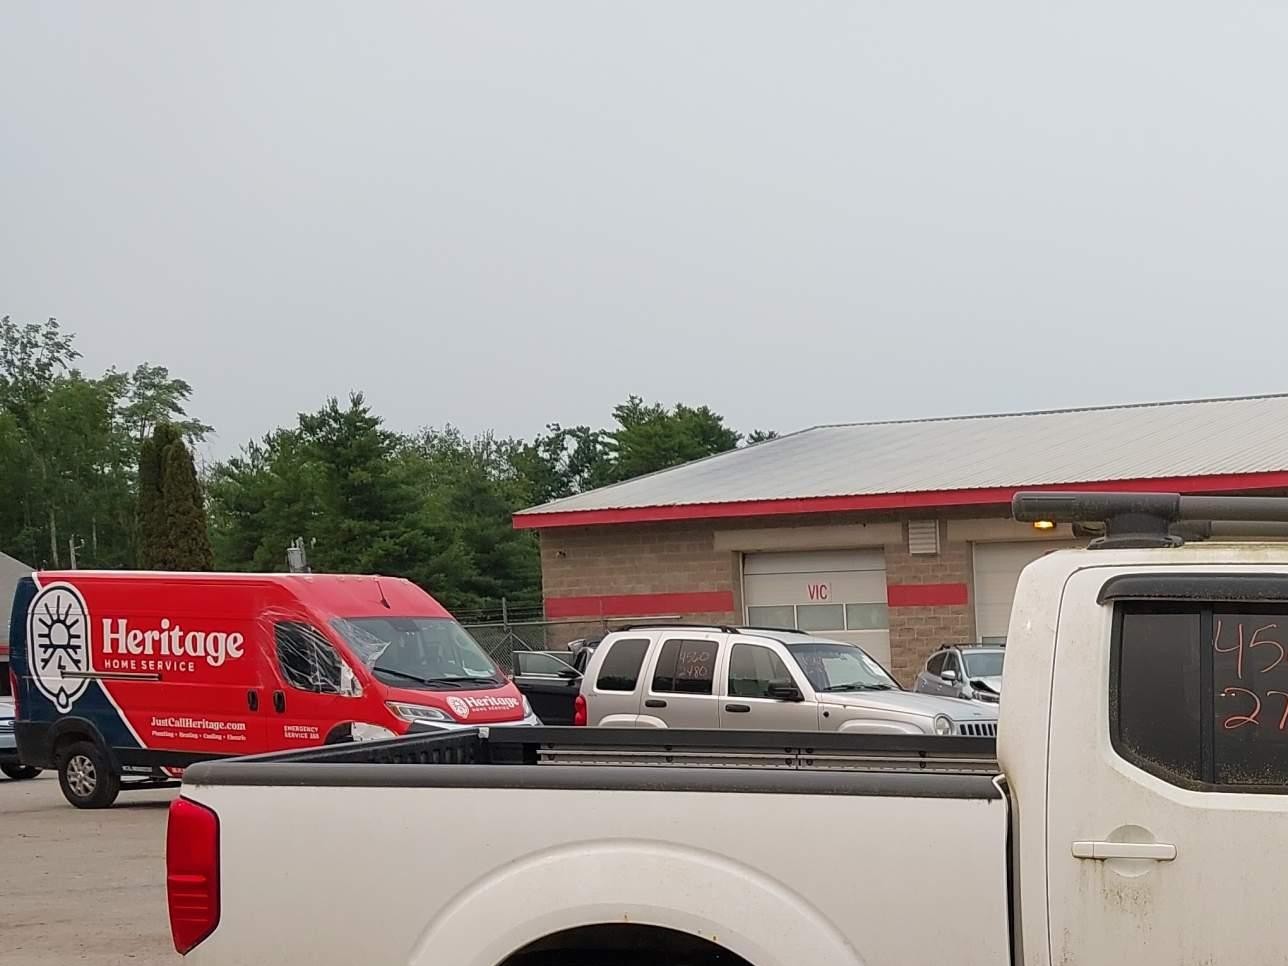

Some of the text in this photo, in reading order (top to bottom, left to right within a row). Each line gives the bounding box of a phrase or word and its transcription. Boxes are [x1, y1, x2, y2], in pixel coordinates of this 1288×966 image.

[808, 584, 828, 600] VIC
[102, 618, 244, 666] Heritage
[104, 659, 195, 672] HOME SERVICE
[464, 696, 519, 708] Heritage
[151, 716, 246, 731] JustCallHeritage.com
